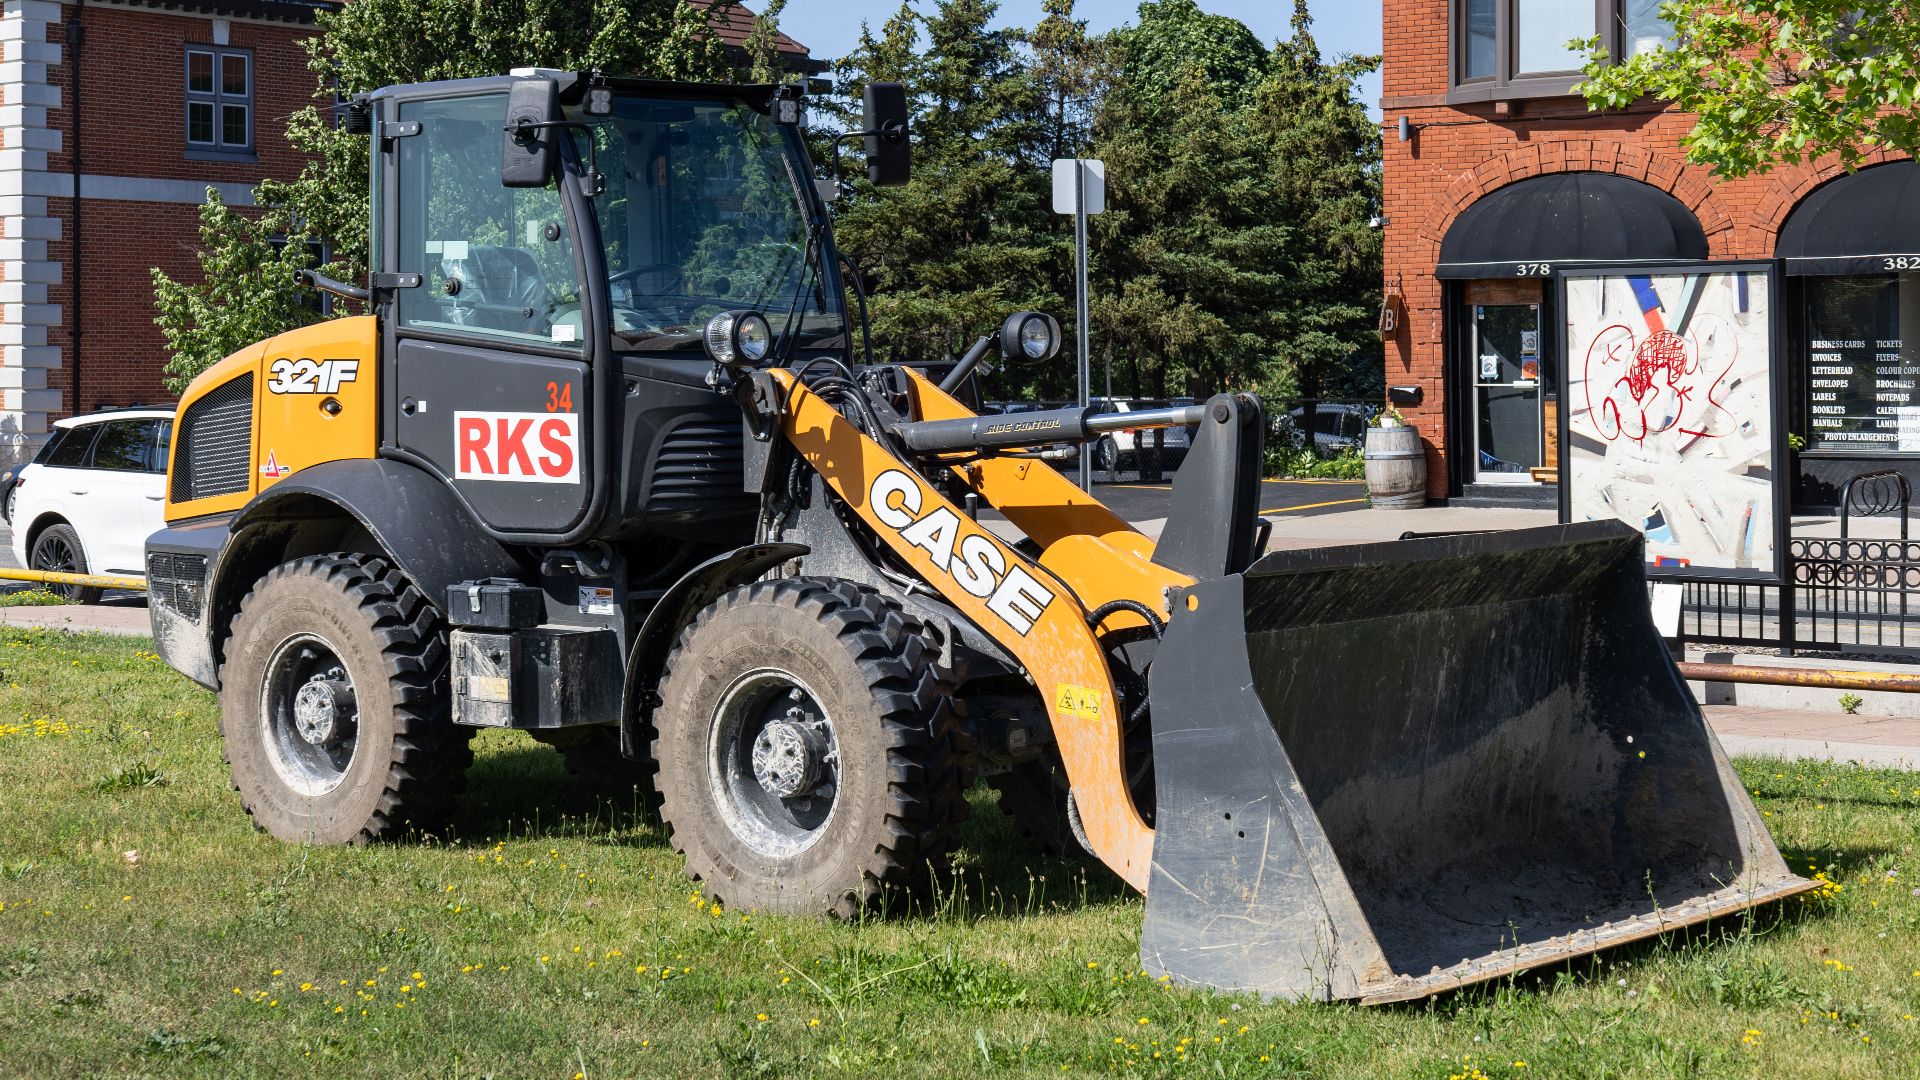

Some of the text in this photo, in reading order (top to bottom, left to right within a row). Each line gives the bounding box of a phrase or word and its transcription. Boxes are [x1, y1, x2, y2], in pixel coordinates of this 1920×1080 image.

[1883, 257, 1920, 270] 382
[1516, 263, 1551, 276] 378
[1812, 340, 1866, 349] BUSINESS CARDS
[1876, 340, 1903, 348] TICKETS
[1812, 353, 1842, 362] INVOICES
[1876, 353, 1899, 362] FLYERS
[1812, 366, 1853, 375] LETTERHEAD
[1876, 366, 1902, 375] COLOUR
[268, 358, 360, 395] 321F
[1812, 379, 1849, 388] ENVELOPES
[1876, 380, 1916, 388] BROCHURES
[546, 382, 573, 413] 34
[1812, 393, 1837, 401] LABELS
[1876, 393, 1910, 402] NOTEPADS
[1812, 406, 1846, 414] BOOKLETS
[987, 419, 1061, 434] RIDE CONTROL
[1812, 419, 1843, 427] MANUALS
[1824, 432, 1898, 442] PHOTO ENLARGEMENTS
[459, 417, 574, 478] RKS
[870, 469, 1056, 638] CASE
